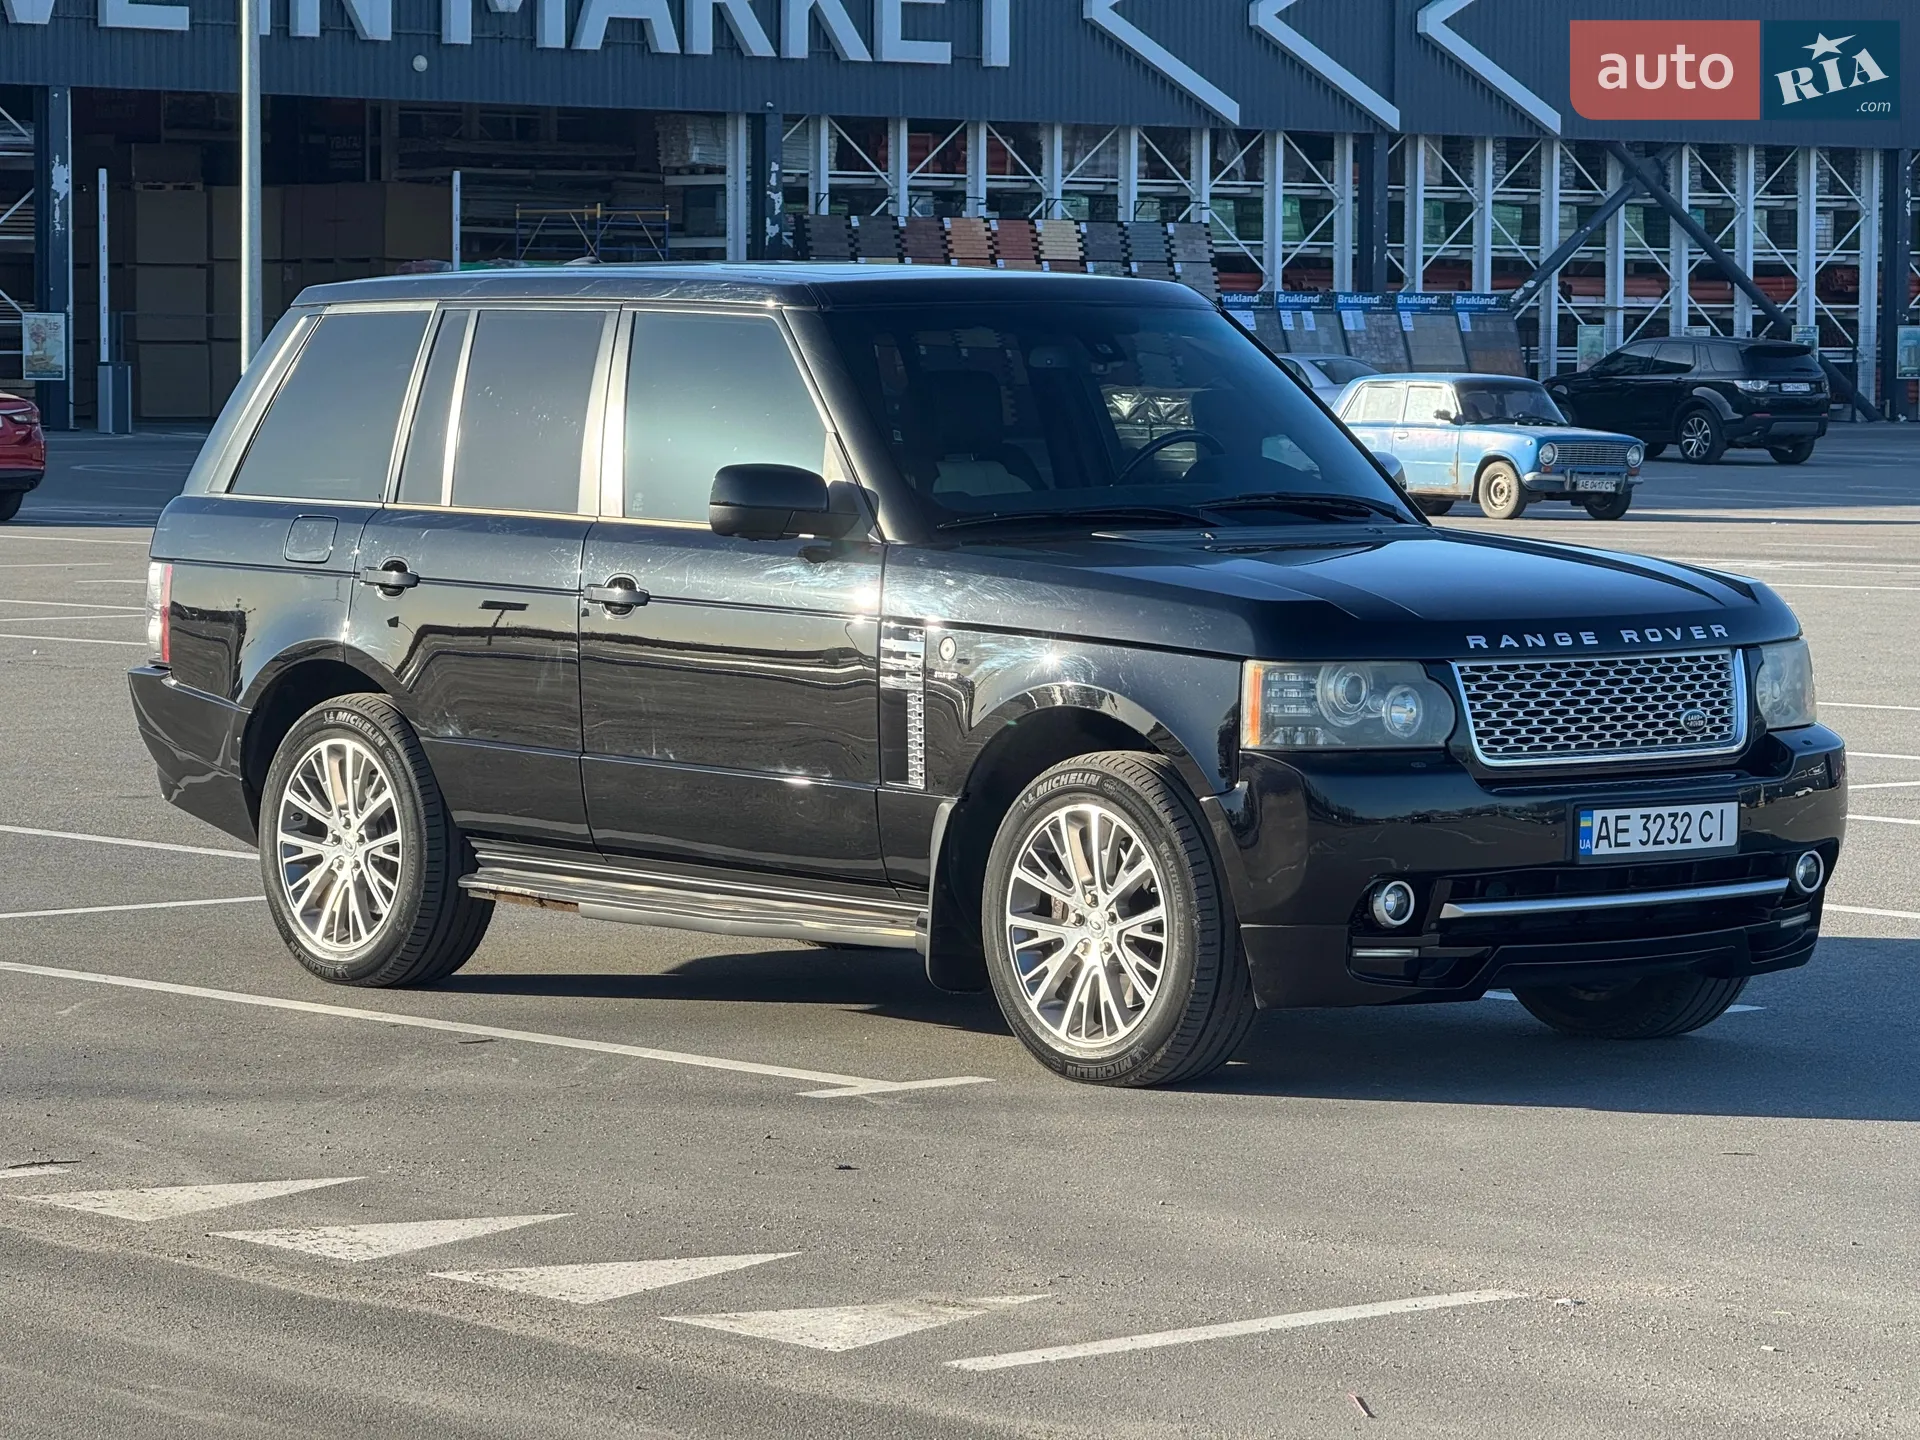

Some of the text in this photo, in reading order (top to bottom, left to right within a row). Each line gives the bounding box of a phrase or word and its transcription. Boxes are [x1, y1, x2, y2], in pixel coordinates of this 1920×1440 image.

[1221, 293, 1260, 303] rukland
[1278, 294, 1320, 303] Brukland
[1338, 295, 1380, 304] Brukland
[1397, 295, 1438, 304] Brukland
[1455, 296, 1497, 305] Brukland
[1466, 624, 1729, 648] RANGE ROVER
[335, 711, 387, 748] MICHELIN
[1036, 772, 1101, 798] MICHELIN
[1594, 815, 1631, 849] AE
[1638, 812, 1692, 846] 3232
[1579, 839, 1591, 850] UA
[1164, 851, 1183, 909] LATITUDE
[1065, 1056, 1133, 1079] MICHELIN
